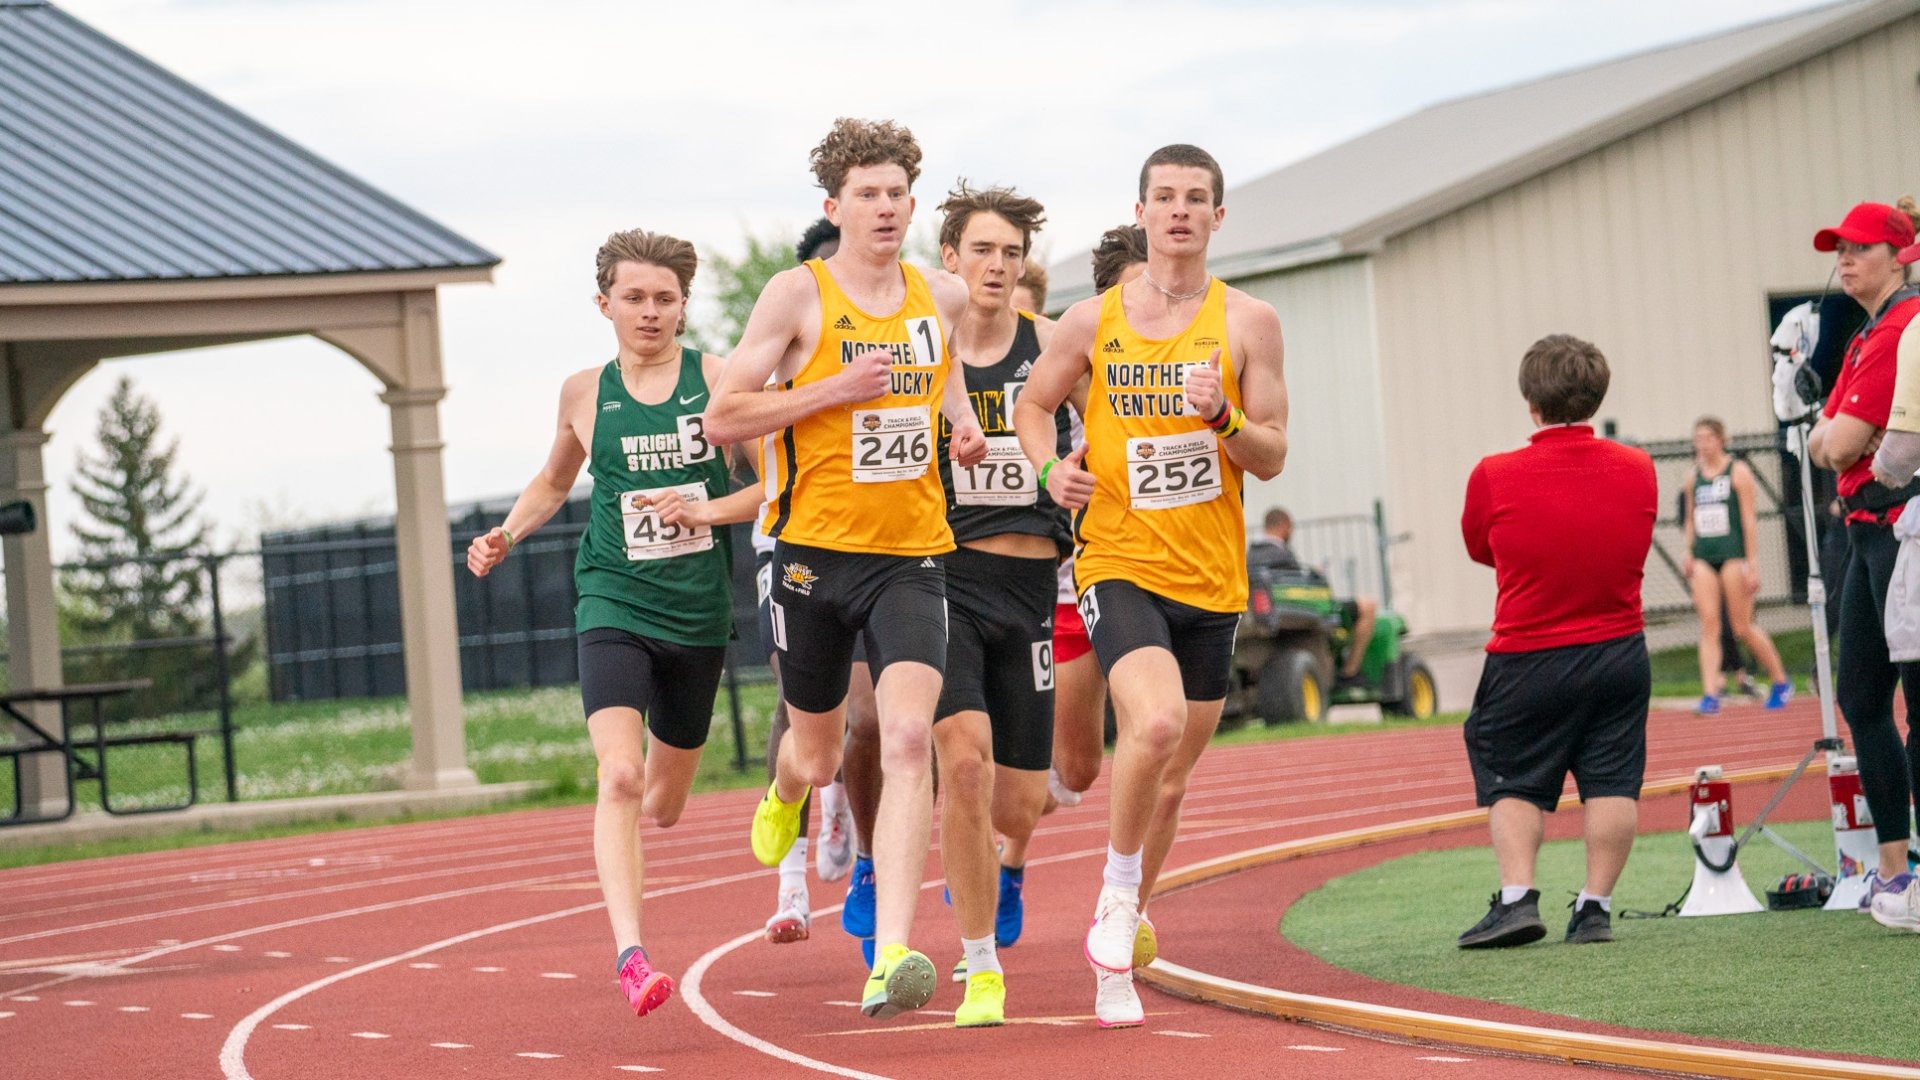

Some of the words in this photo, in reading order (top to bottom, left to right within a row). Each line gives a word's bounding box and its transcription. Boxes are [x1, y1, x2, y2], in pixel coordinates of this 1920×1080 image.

[917, 320, 935, 362] 1
[890, 372, 933, 395] UCKY
[1107, 361, 1210, 387] NORTHE
[1109, 393, 1184, 416] KENTUC
[621, 433, 682, 454] WRIGH
[686, 416, 708, 460] 3
[859, 432, 928, 466] 246
[1158, 445, 1209, 457] CHAMPIONSHIPS
[627, 452, 684, 472] STATE
[964, 462, 1024, 490] 178
[1136, 457, 1214, 494] 252
[782, 580, 795, 591] TRACK
[1039, 643, 1052, 686] 9
